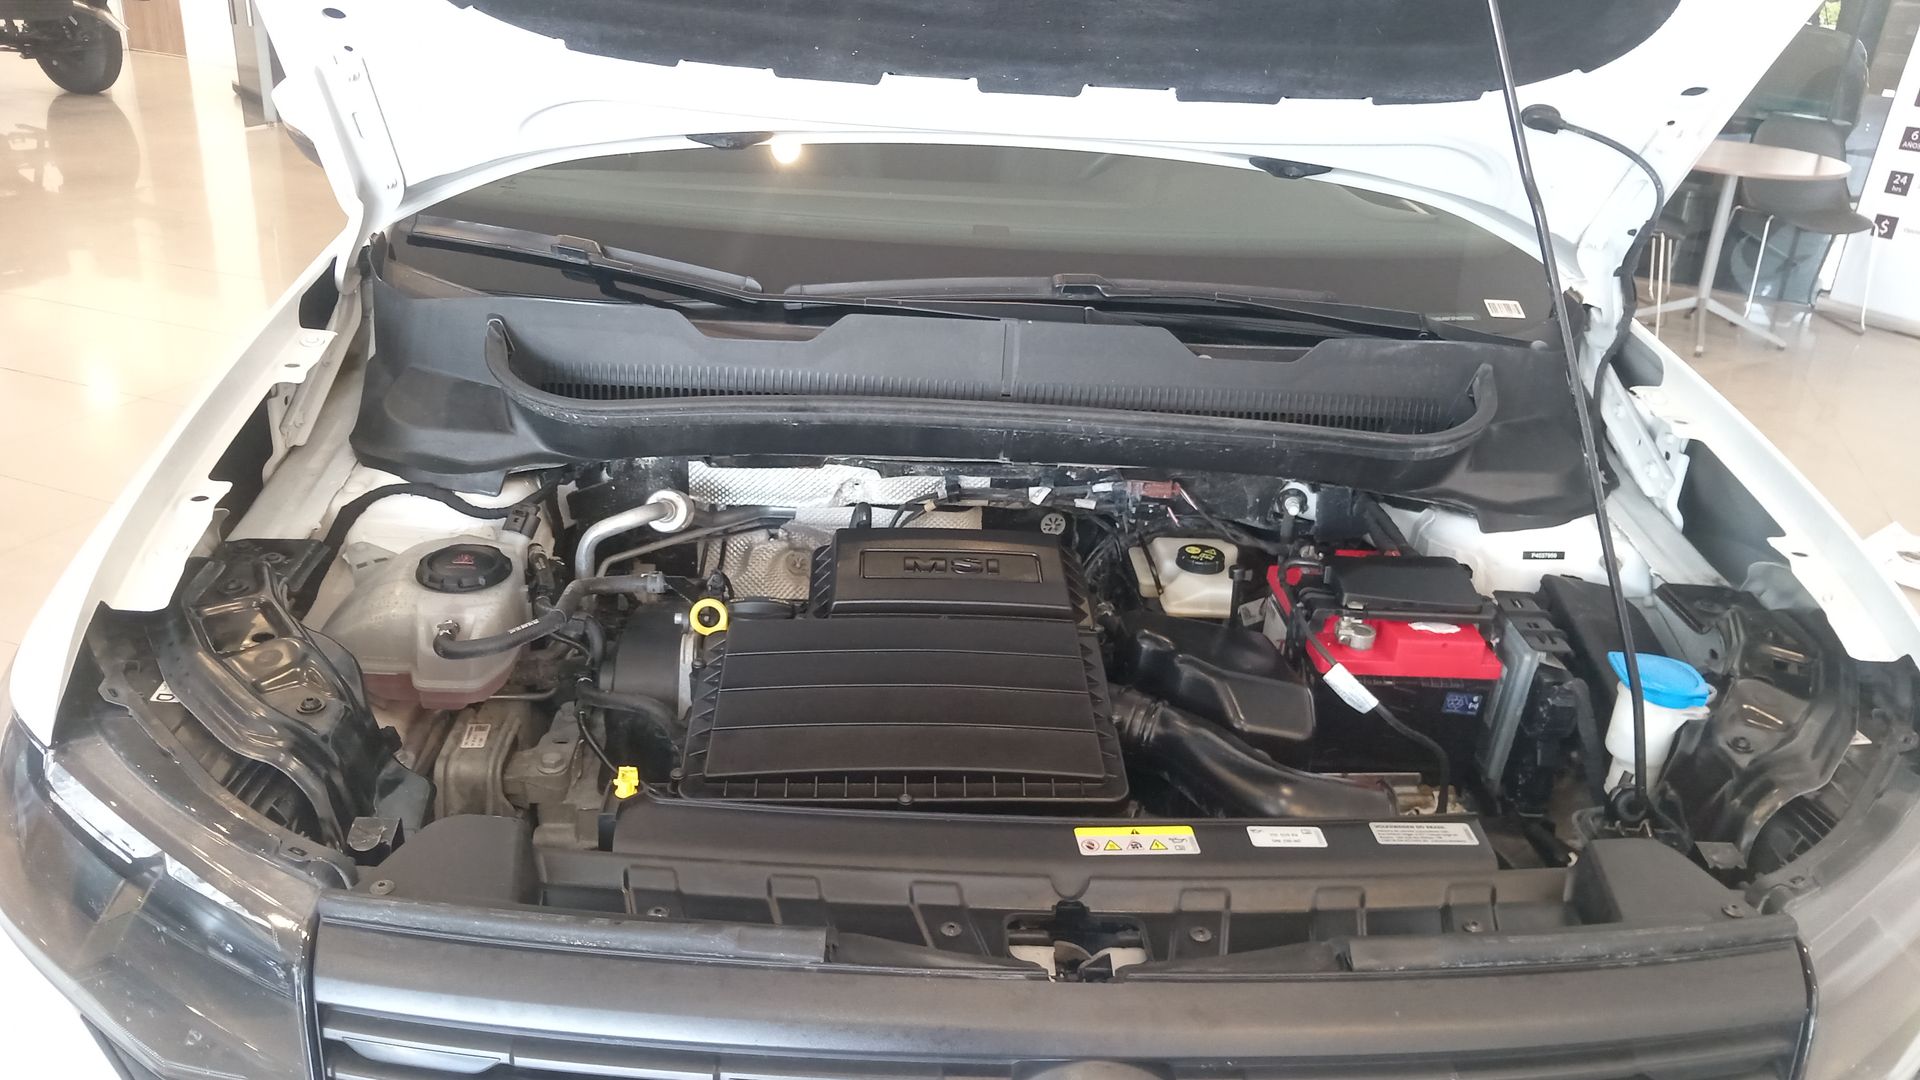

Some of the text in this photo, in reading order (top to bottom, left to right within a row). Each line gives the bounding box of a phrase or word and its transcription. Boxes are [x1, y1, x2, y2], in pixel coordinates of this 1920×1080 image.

[1910, 130, 1920, 141] 6
[1892, 174, 1908, 186] 24
[1891, 185, 1902, 193] hrs
[903, 556, 1000, 575] MSI
